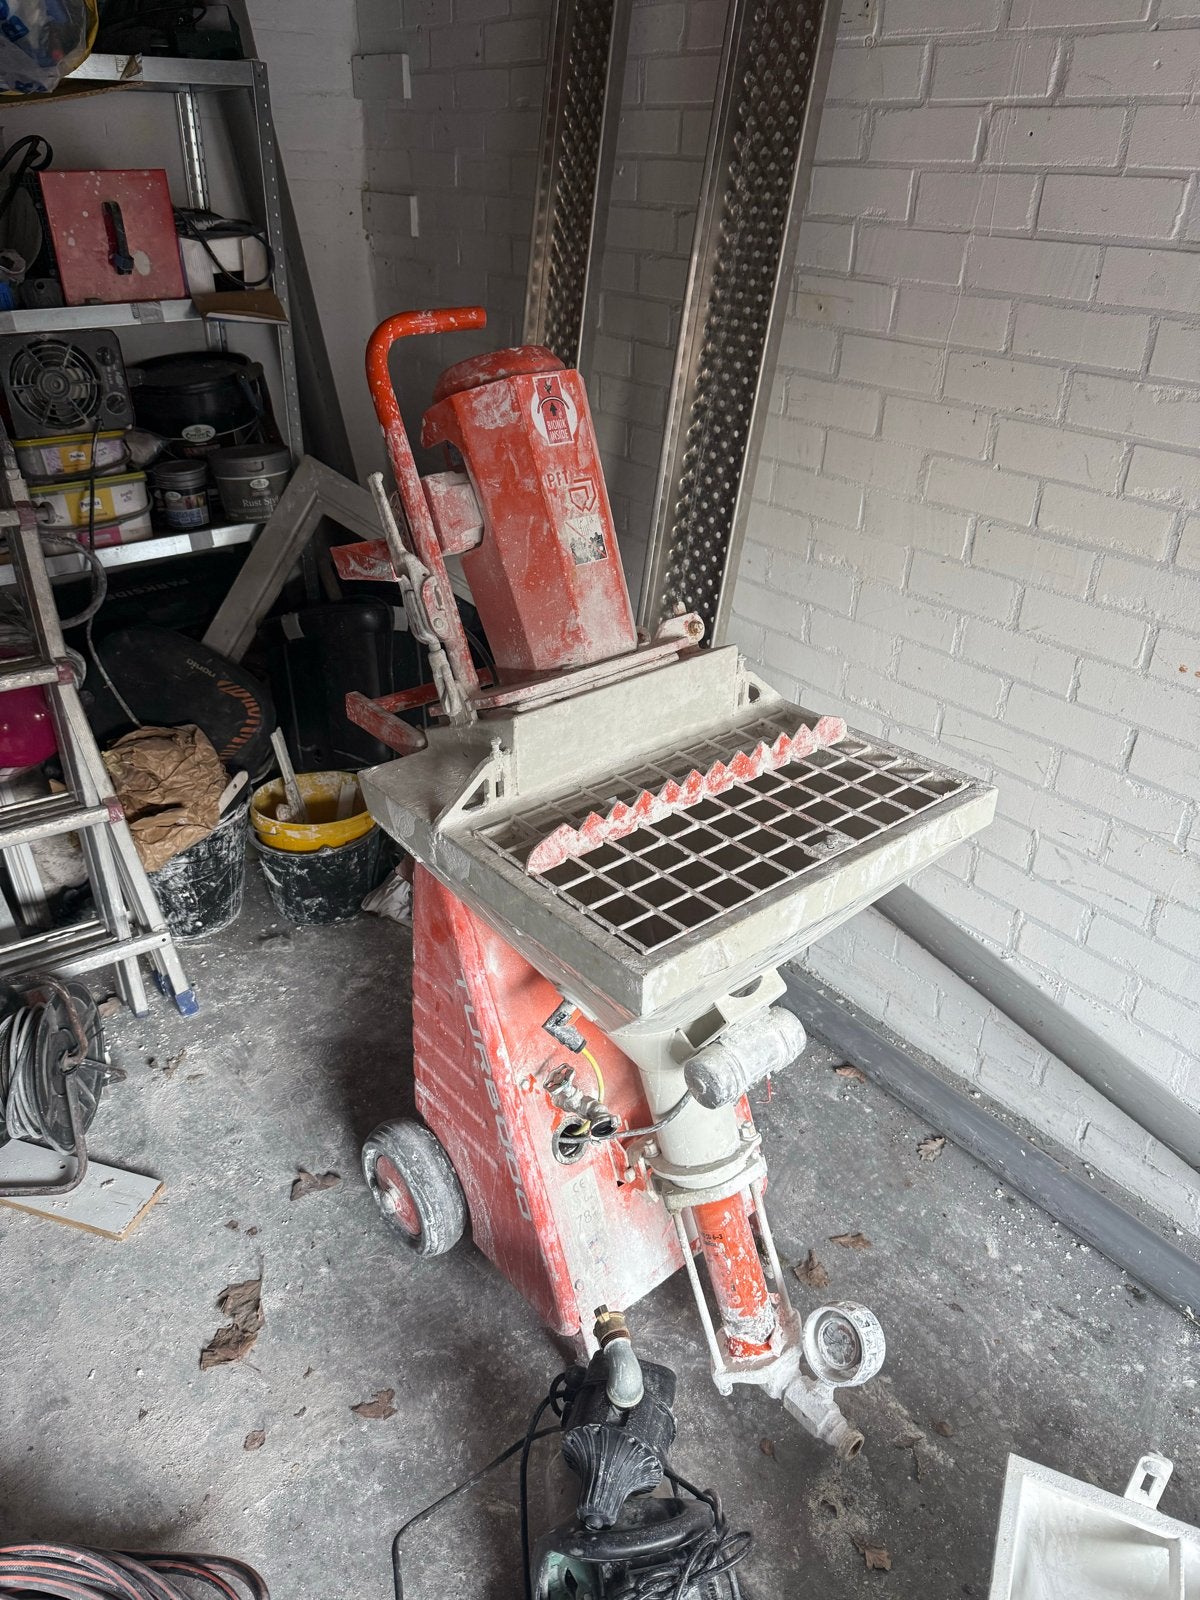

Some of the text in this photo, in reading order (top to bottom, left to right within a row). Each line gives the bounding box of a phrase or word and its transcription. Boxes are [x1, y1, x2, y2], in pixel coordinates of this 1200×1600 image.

[549, 428, 569, 441] INSIDE
[546, 470, 570, 488] PFT
[242, 496, 262, 508] Rust
